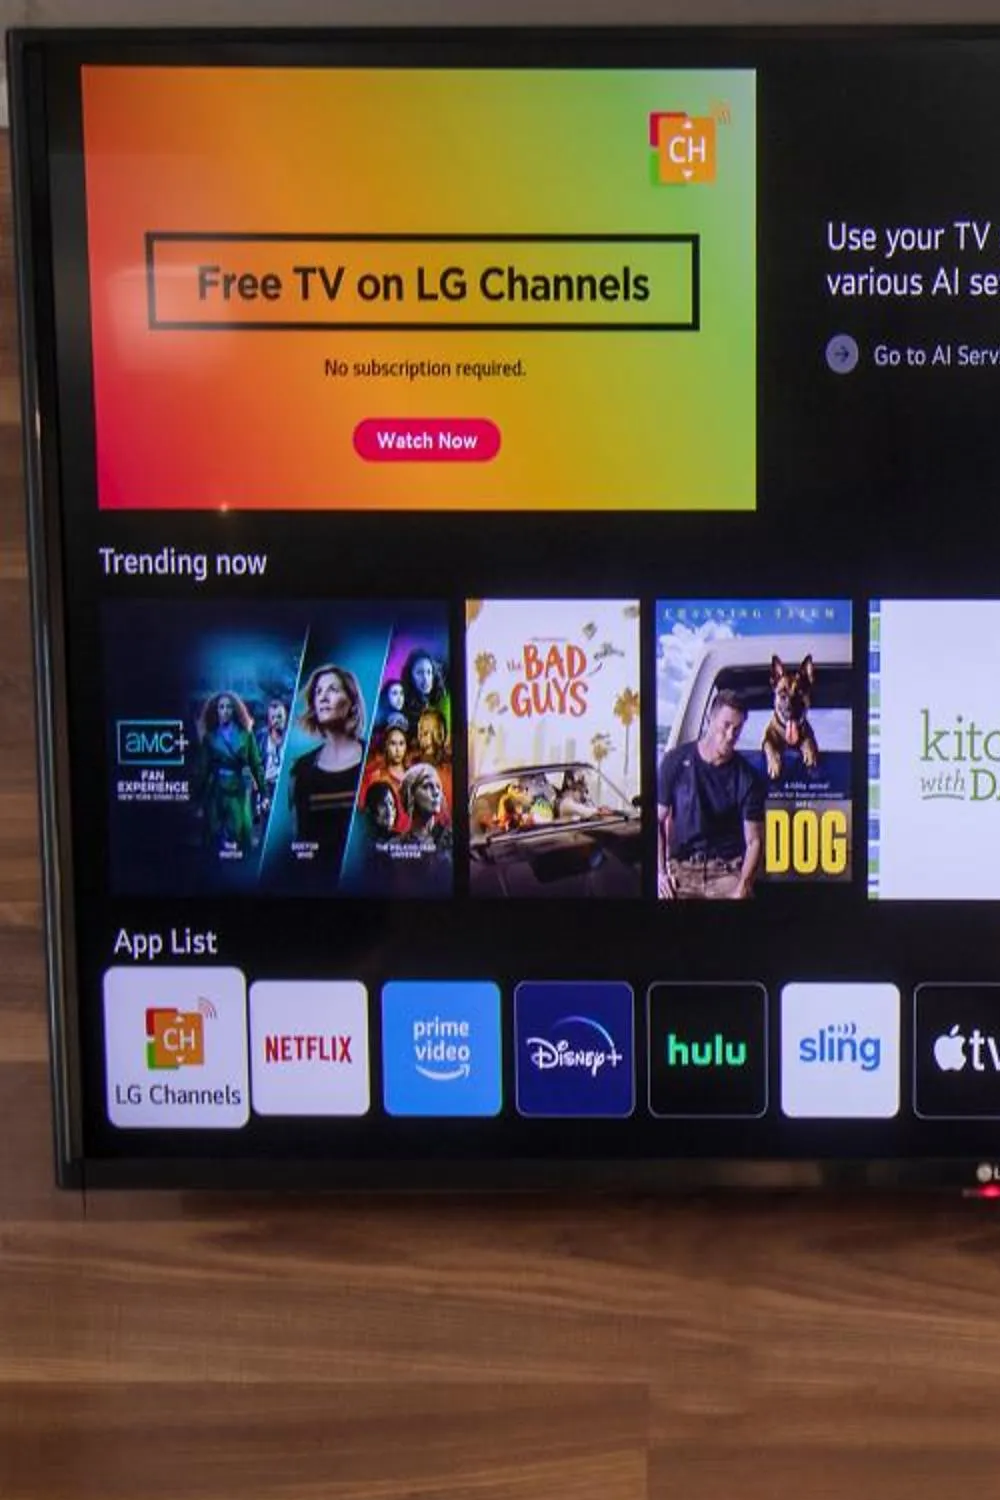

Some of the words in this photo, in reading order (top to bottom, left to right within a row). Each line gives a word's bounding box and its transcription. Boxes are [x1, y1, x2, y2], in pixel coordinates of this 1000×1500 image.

[669, 136, 707, 165] CH
[827, 222, 877, 251] Use
[885, 227, 944, 258] your
[953, 222, 990, 249] TV
[198, 266, 282, 301] Free
[294, 267, 343, 301] TV
[357, 275, 403, 301] on
[418, 266, 467, 301] LG
[480, 265, 650, 301] Channels
[827, 268, 922, 296] various
[932, 267, 960, 295] AI
[324, 360, 348, 377] No
[353, 358, 451, 381] subscription
[456, 358, 526, 381] required.
[874, 346, 901, 366] Go
[907, 348, 928, 366] to
[932, 346, 951, 366] AI
[377, 431, 433, 450] Watch
[438, 431, 478, 450] Now
[100, 548, 207, 581] Trending
[217, 553, 267, 575] now
[523, 644, 587, 680] BAD
[511, 679, 589, 717] GUYS
[117, 781, 189, 793] EXPERIENCE
[141, 769, 165, 781] FAN
[920, 769, 965, 793] with
[765, 809, 847, 875] DOG
[114, 930, 163, 959] App
[171, 928, 217, 954] List
[162, 1028, 197, 1051] CH
[413, 1017, 470, 1041] prime
[265, 1035, 352, 1064] NETFLIX
[414, 1040, 470, 1063] video
[667, 1033, 747, 1066] hulu
[799, 1022, 881, 1071] sling
[115, 1085, 143, 1106] LG
[149, 1083, 241, 1106] Channels
